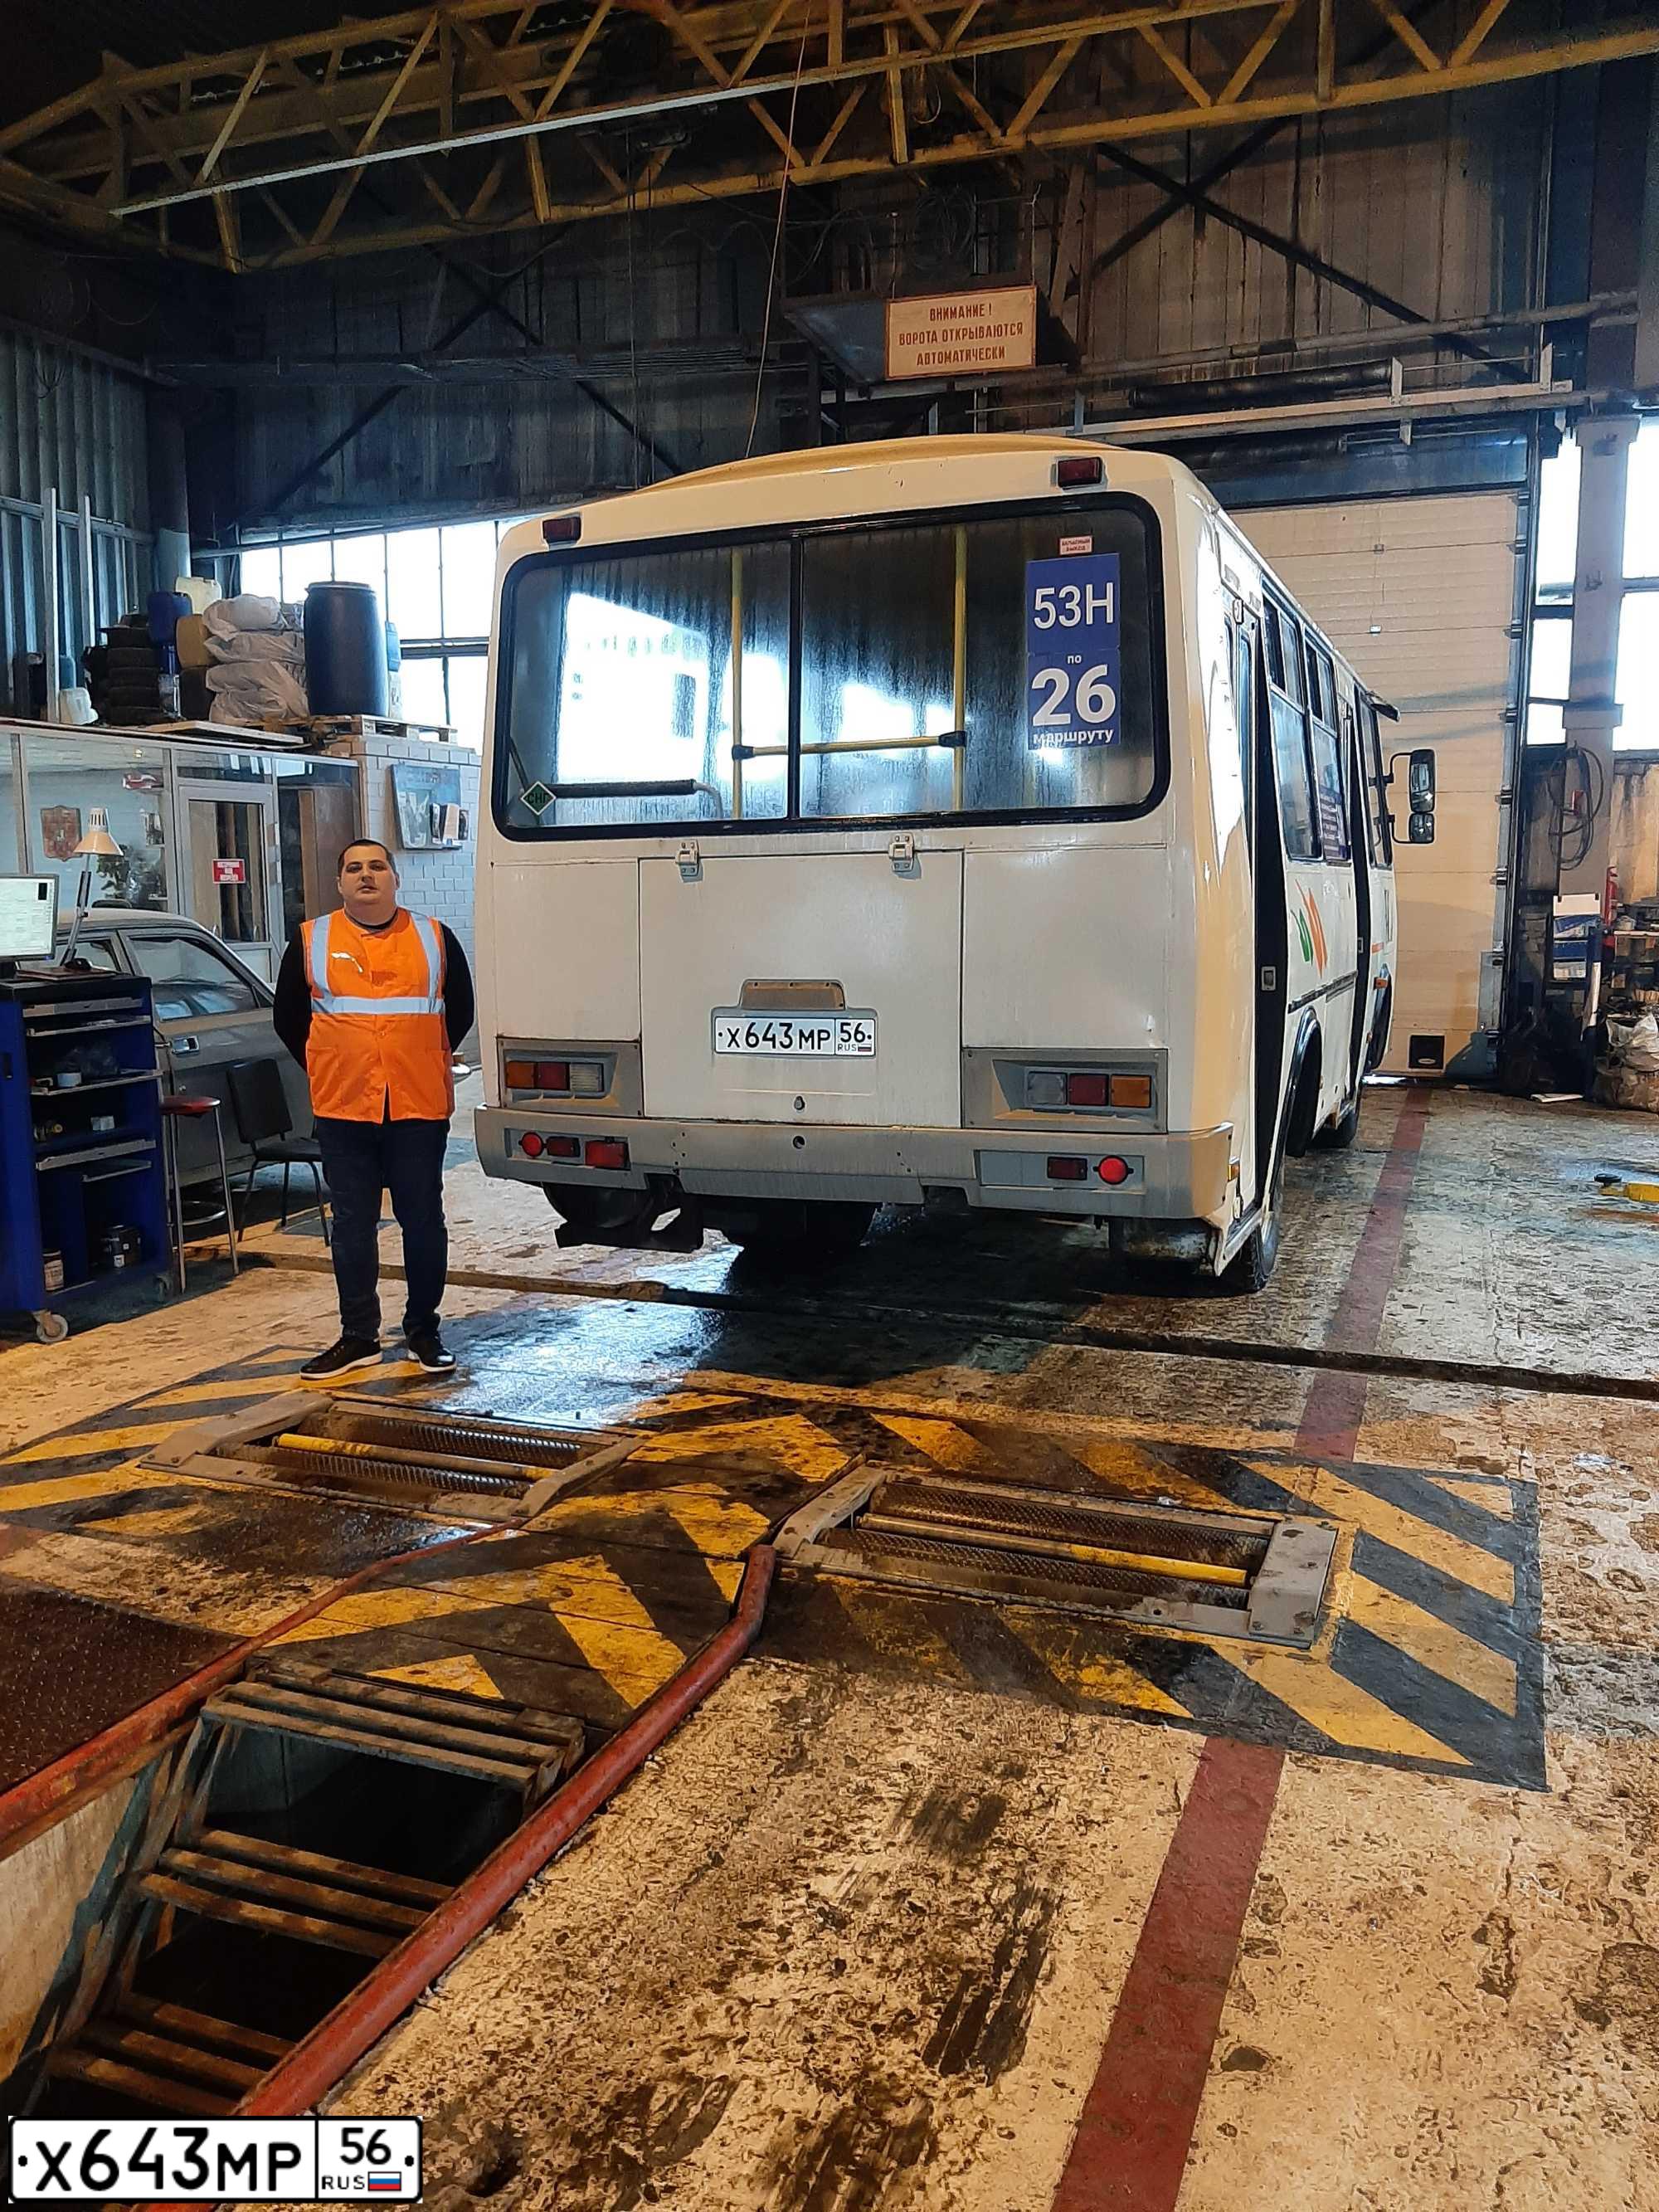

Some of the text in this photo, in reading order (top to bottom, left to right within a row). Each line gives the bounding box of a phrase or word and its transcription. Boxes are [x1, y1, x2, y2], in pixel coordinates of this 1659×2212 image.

[930, 304, 985, 321] ВНИМАНИЕ
[899, 322, 1023, 346] ВОРОТА ОТКРЫВАЮТСЯ
[1067, 654, 1082, 665] по
[1031, 664, 1116, 727] 26
[1033, 728, 1114, 747] маршруту
[839, 1022, 866, 1043] 56
[837, 1044, 857, 1052] RUS
